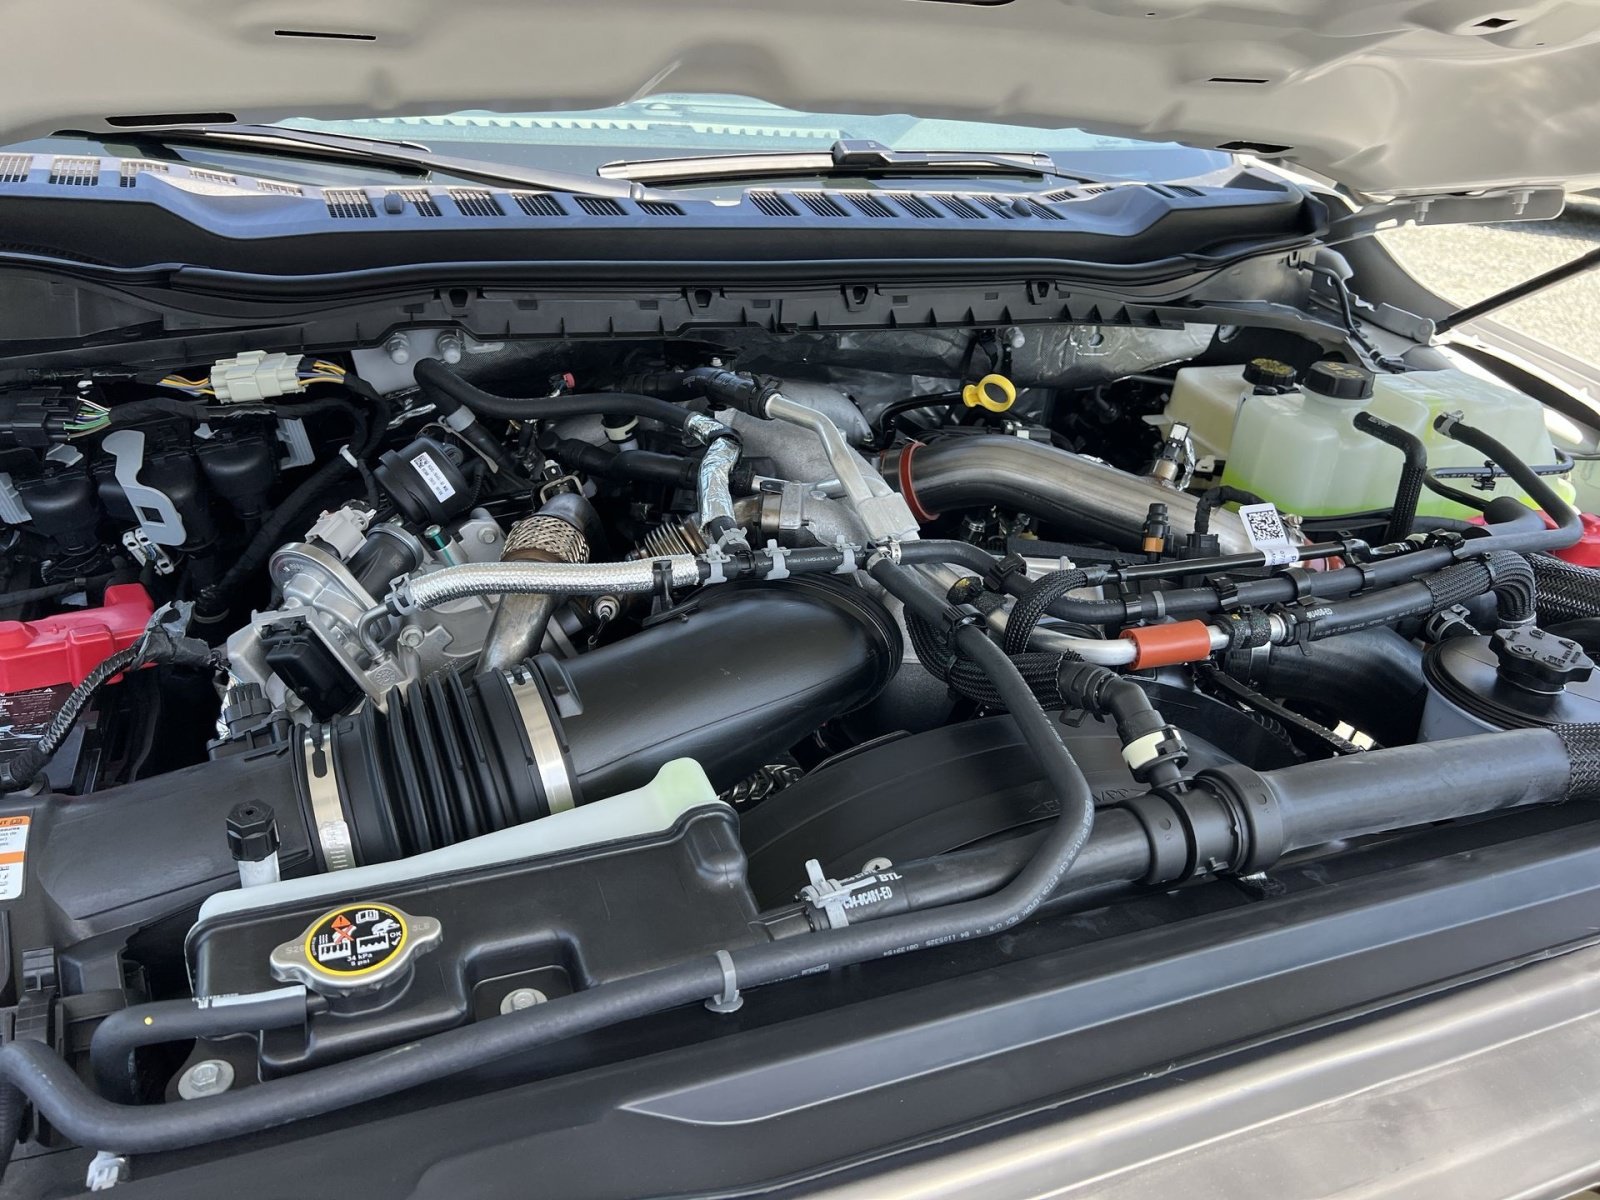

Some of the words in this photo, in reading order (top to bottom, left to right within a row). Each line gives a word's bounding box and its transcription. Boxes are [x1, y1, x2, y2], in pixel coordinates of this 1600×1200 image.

[877, 872, 903, 883] BTL
[389, 931, 402, 939] OK
[346, 954, 358, 962] 34
[357, 952, 373, 960] kPa
[357, 957, 370, 967] psi
